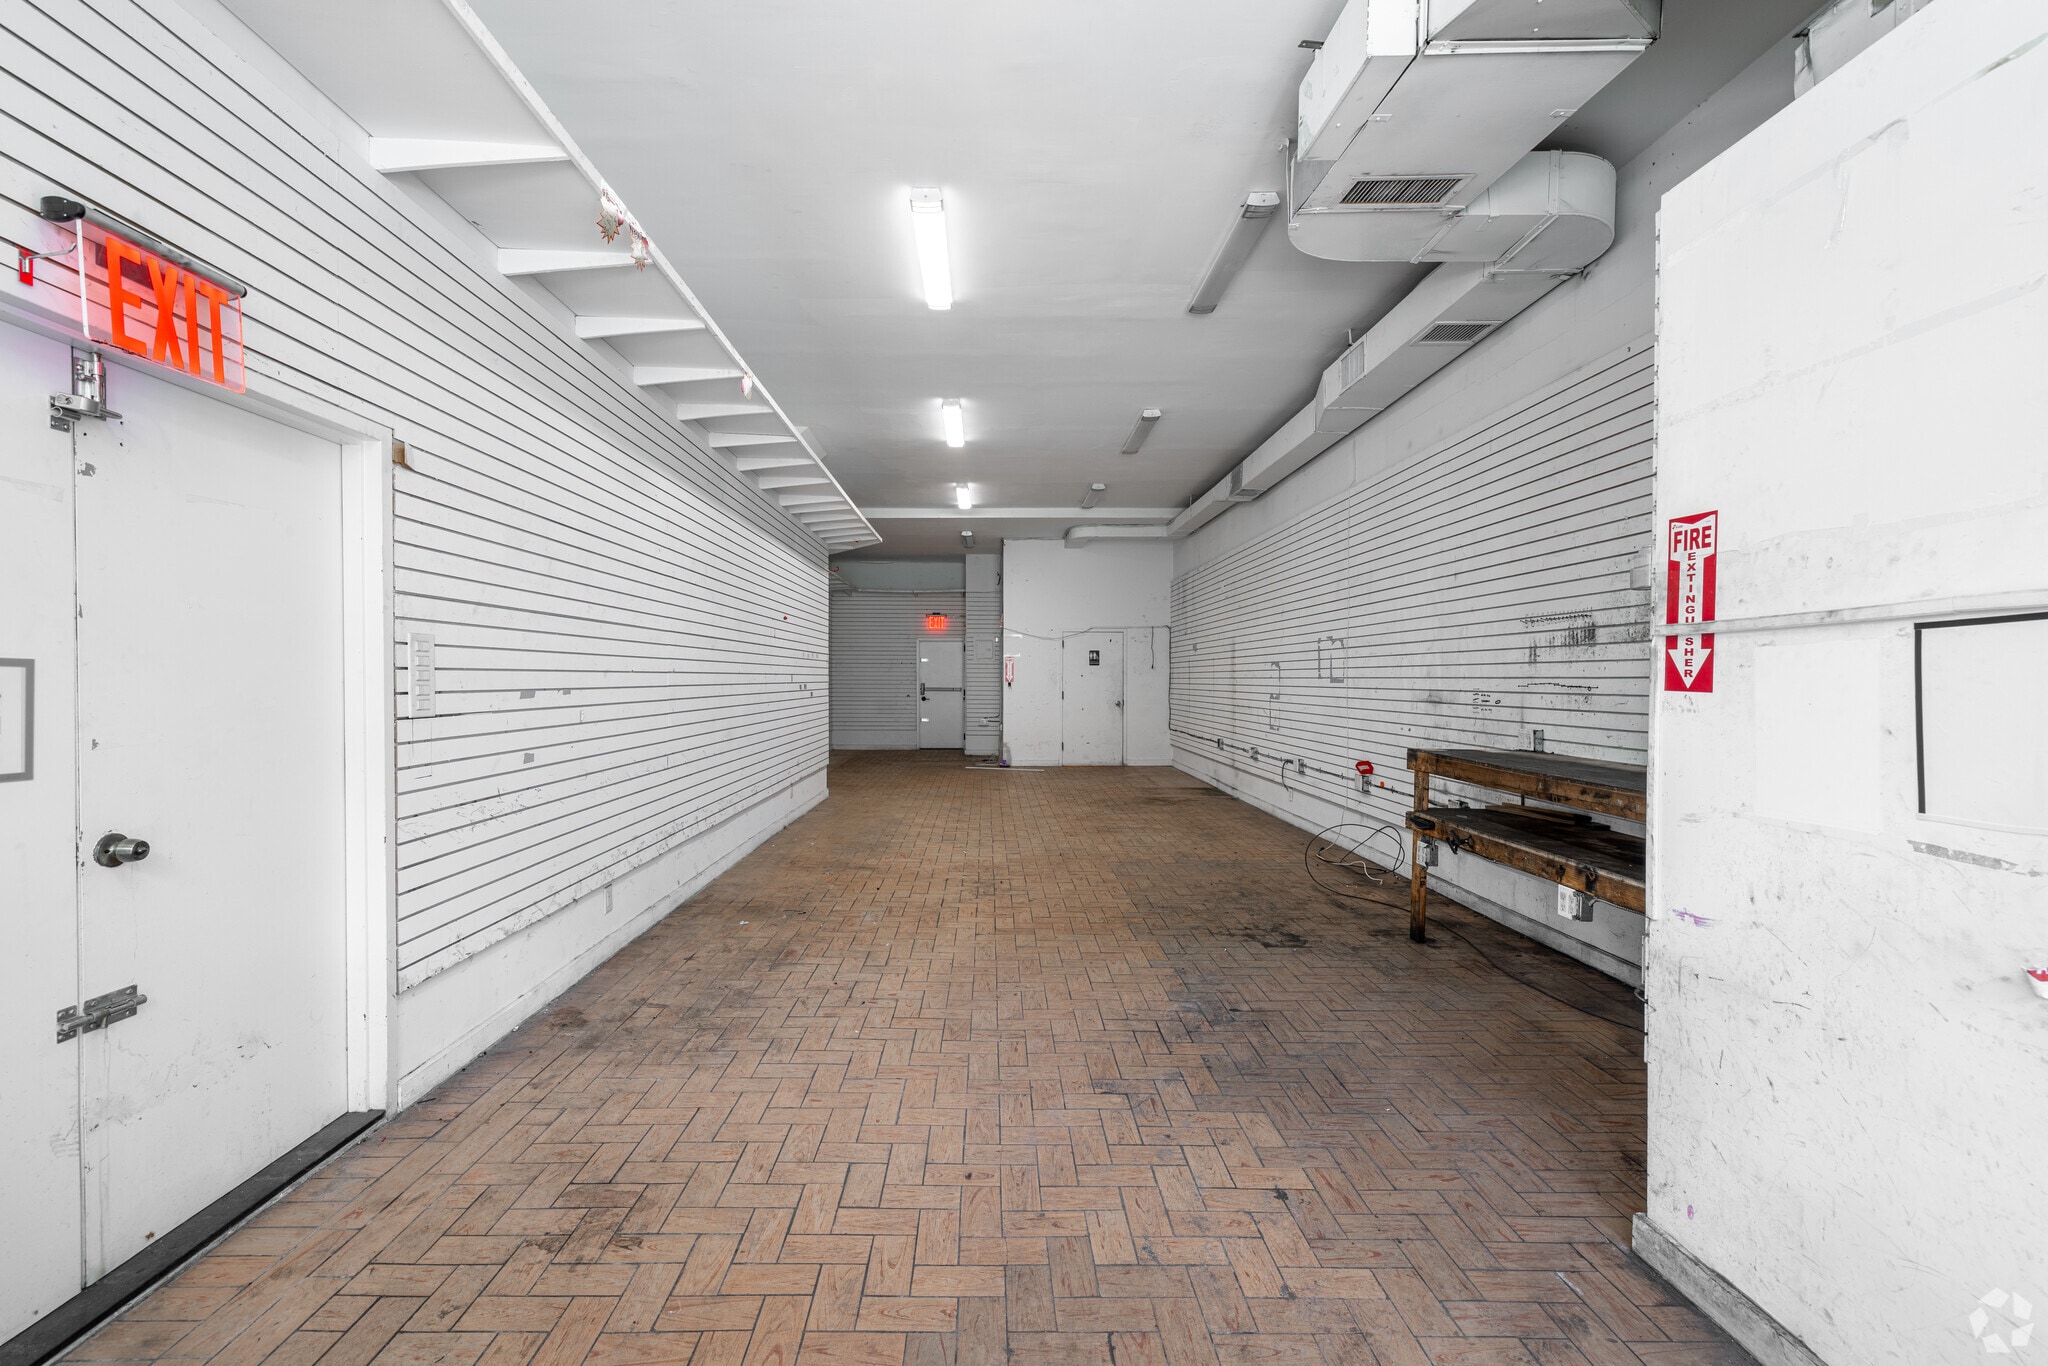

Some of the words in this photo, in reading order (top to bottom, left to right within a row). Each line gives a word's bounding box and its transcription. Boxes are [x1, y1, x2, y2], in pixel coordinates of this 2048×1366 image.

[105, 236, 229, 384] EXIT
[1673, 525, 1712, 553] FIRE
[928, 616, 945, 629] EXIT
[1683, 552, 1697, 678] EXTINGUSHER
